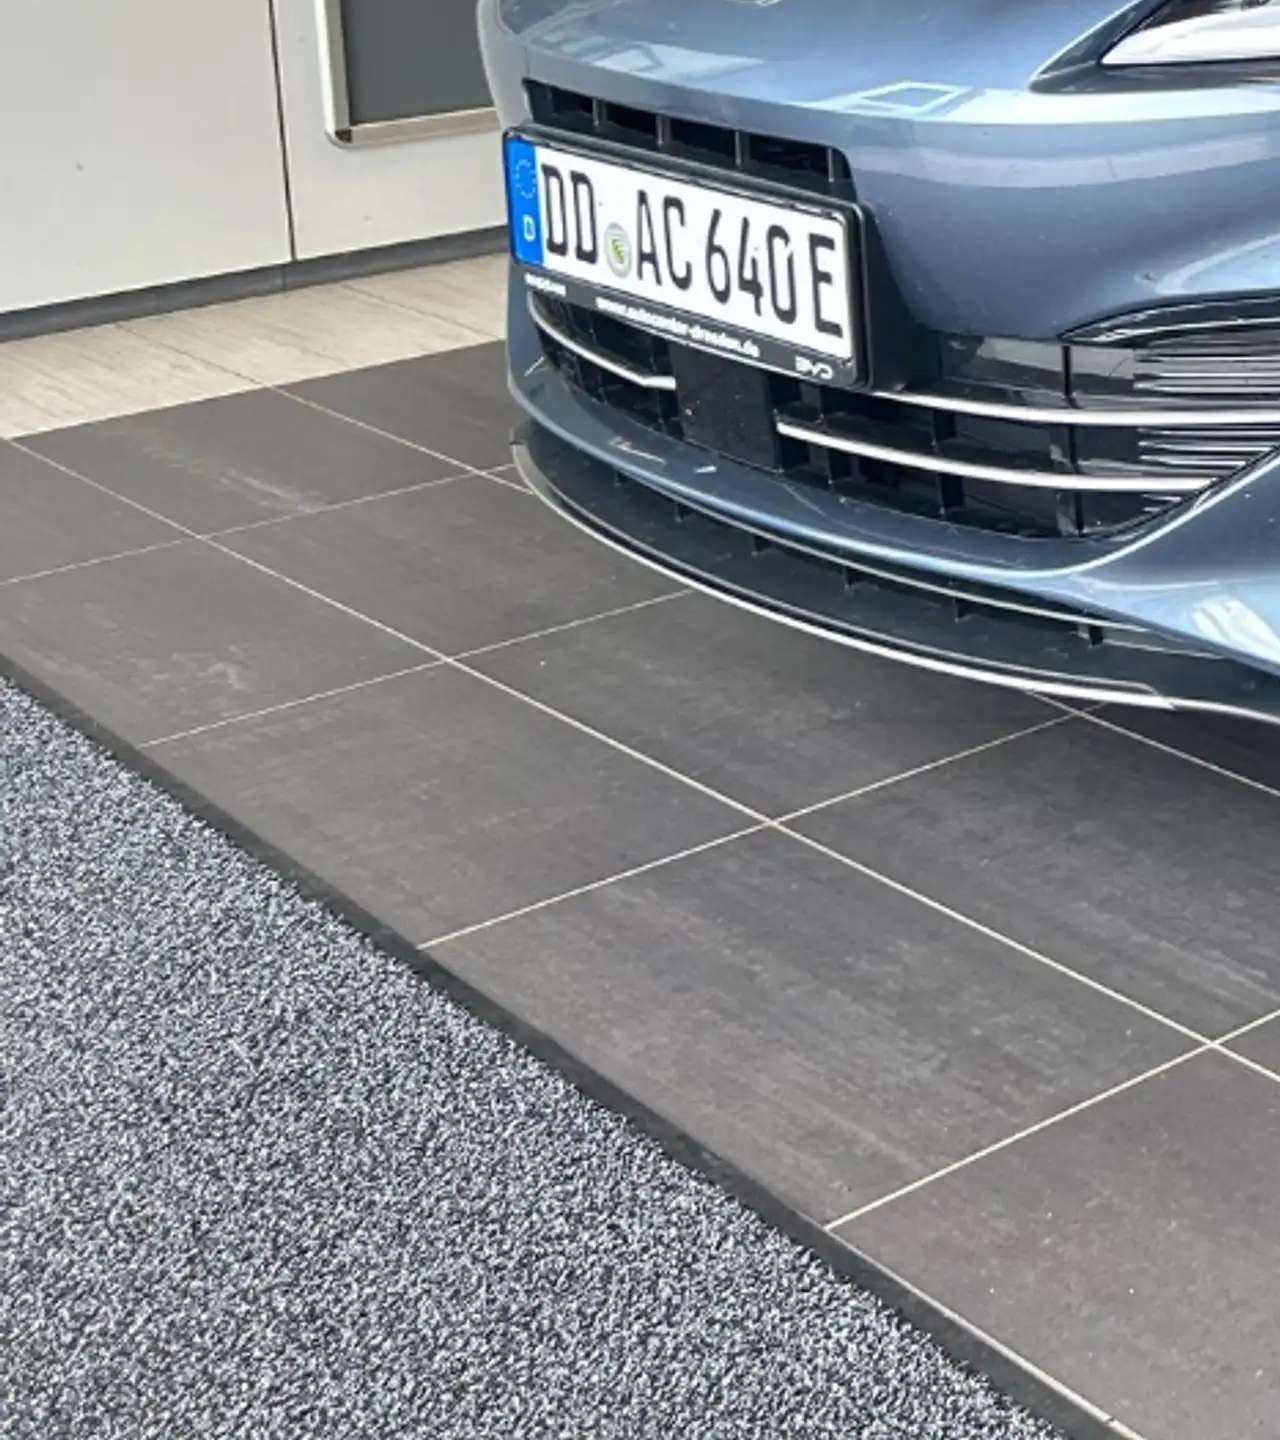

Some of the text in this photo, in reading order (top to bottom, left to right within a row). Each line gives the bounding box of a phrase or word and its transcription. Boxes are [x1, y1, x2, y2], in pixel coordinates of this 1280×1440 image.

[523, 214, 536, 242] D
[540, 163, 599, 265] DD
[636, 190, 693, 292] AC
